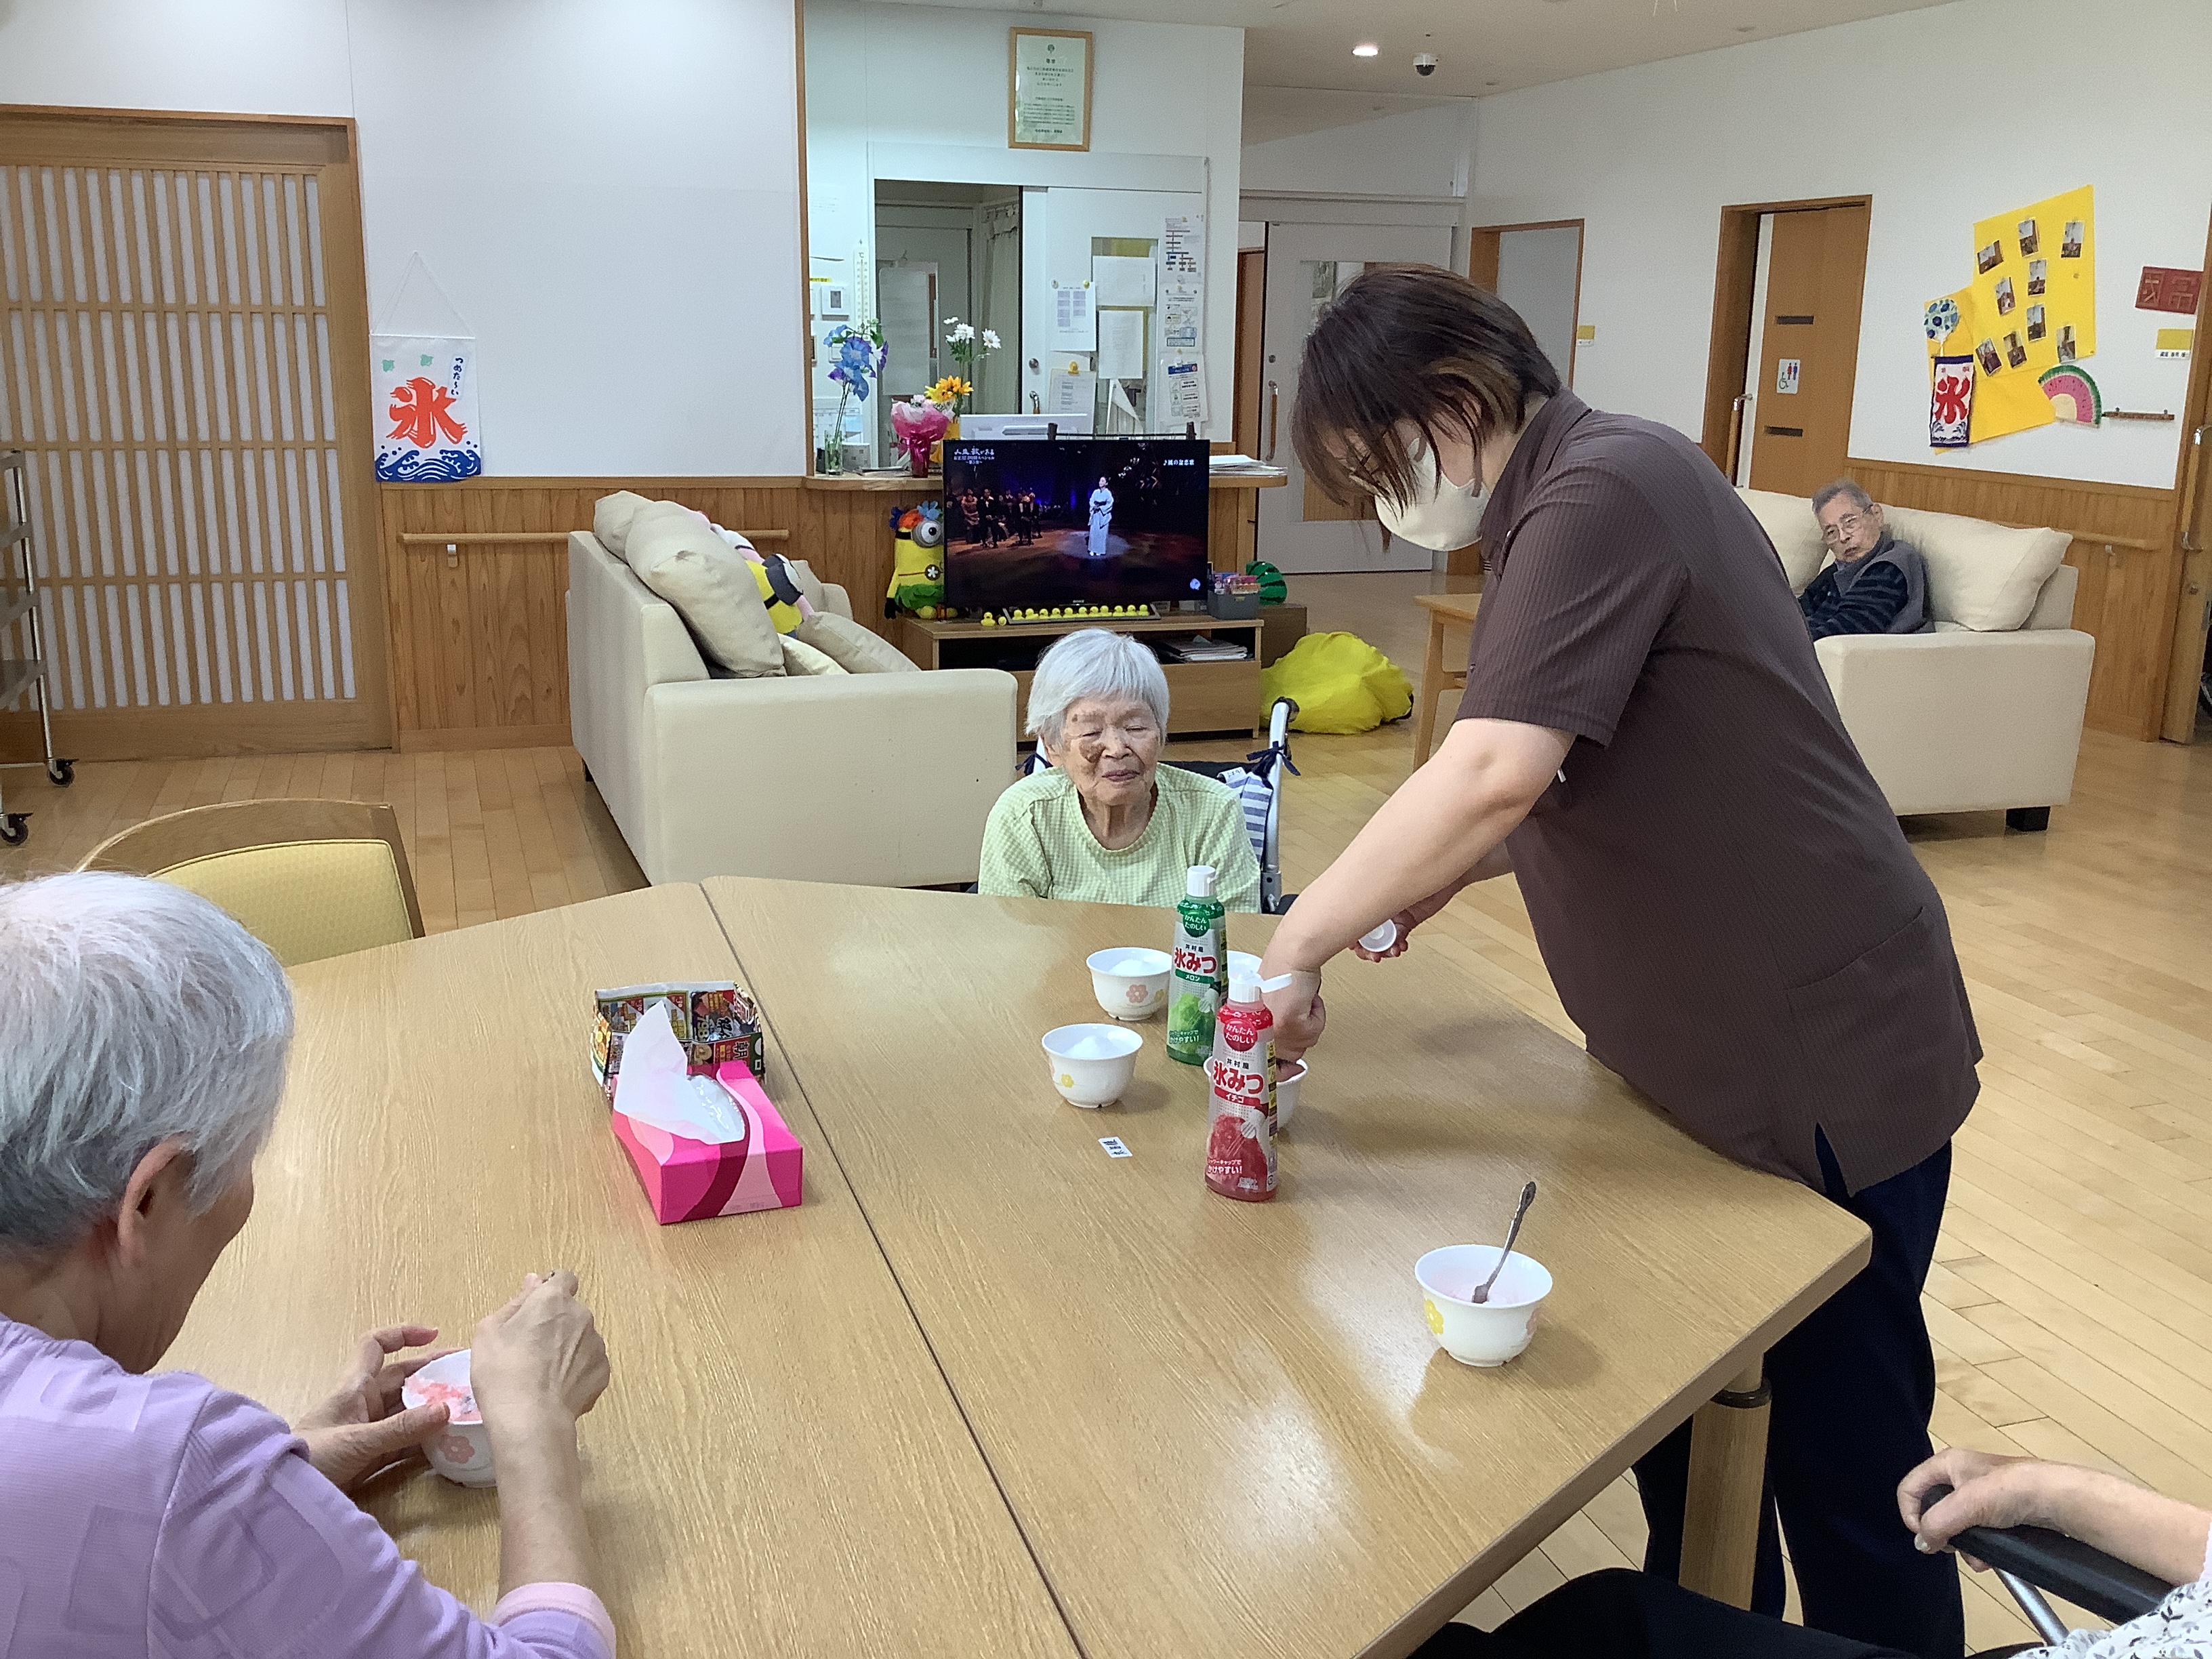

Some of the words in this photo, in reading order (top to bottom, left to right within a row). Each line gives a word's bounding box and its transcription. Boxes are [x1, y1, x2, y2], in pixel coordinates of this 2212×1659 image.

[1935, 375, 1970, 424] 氷
[386, 377, 468, 449] 氷
[1185, 914, 1207, 924] かんたん
[1185, 922, 1206, 930] たのしい
[1174, 947, 1217, 974] 氷みつ
[697, 1015, 710, 1040] 798
[1225, 1023, 1254, 1036] かんたん
[1225, 1032, 1254, 1044] たのしい
[733, 1041, 750, 1059] 朝
[1213, 1061, 1263, 1094] 氷みつ
[1226, 1093, 1244, 1103] イチゴ
